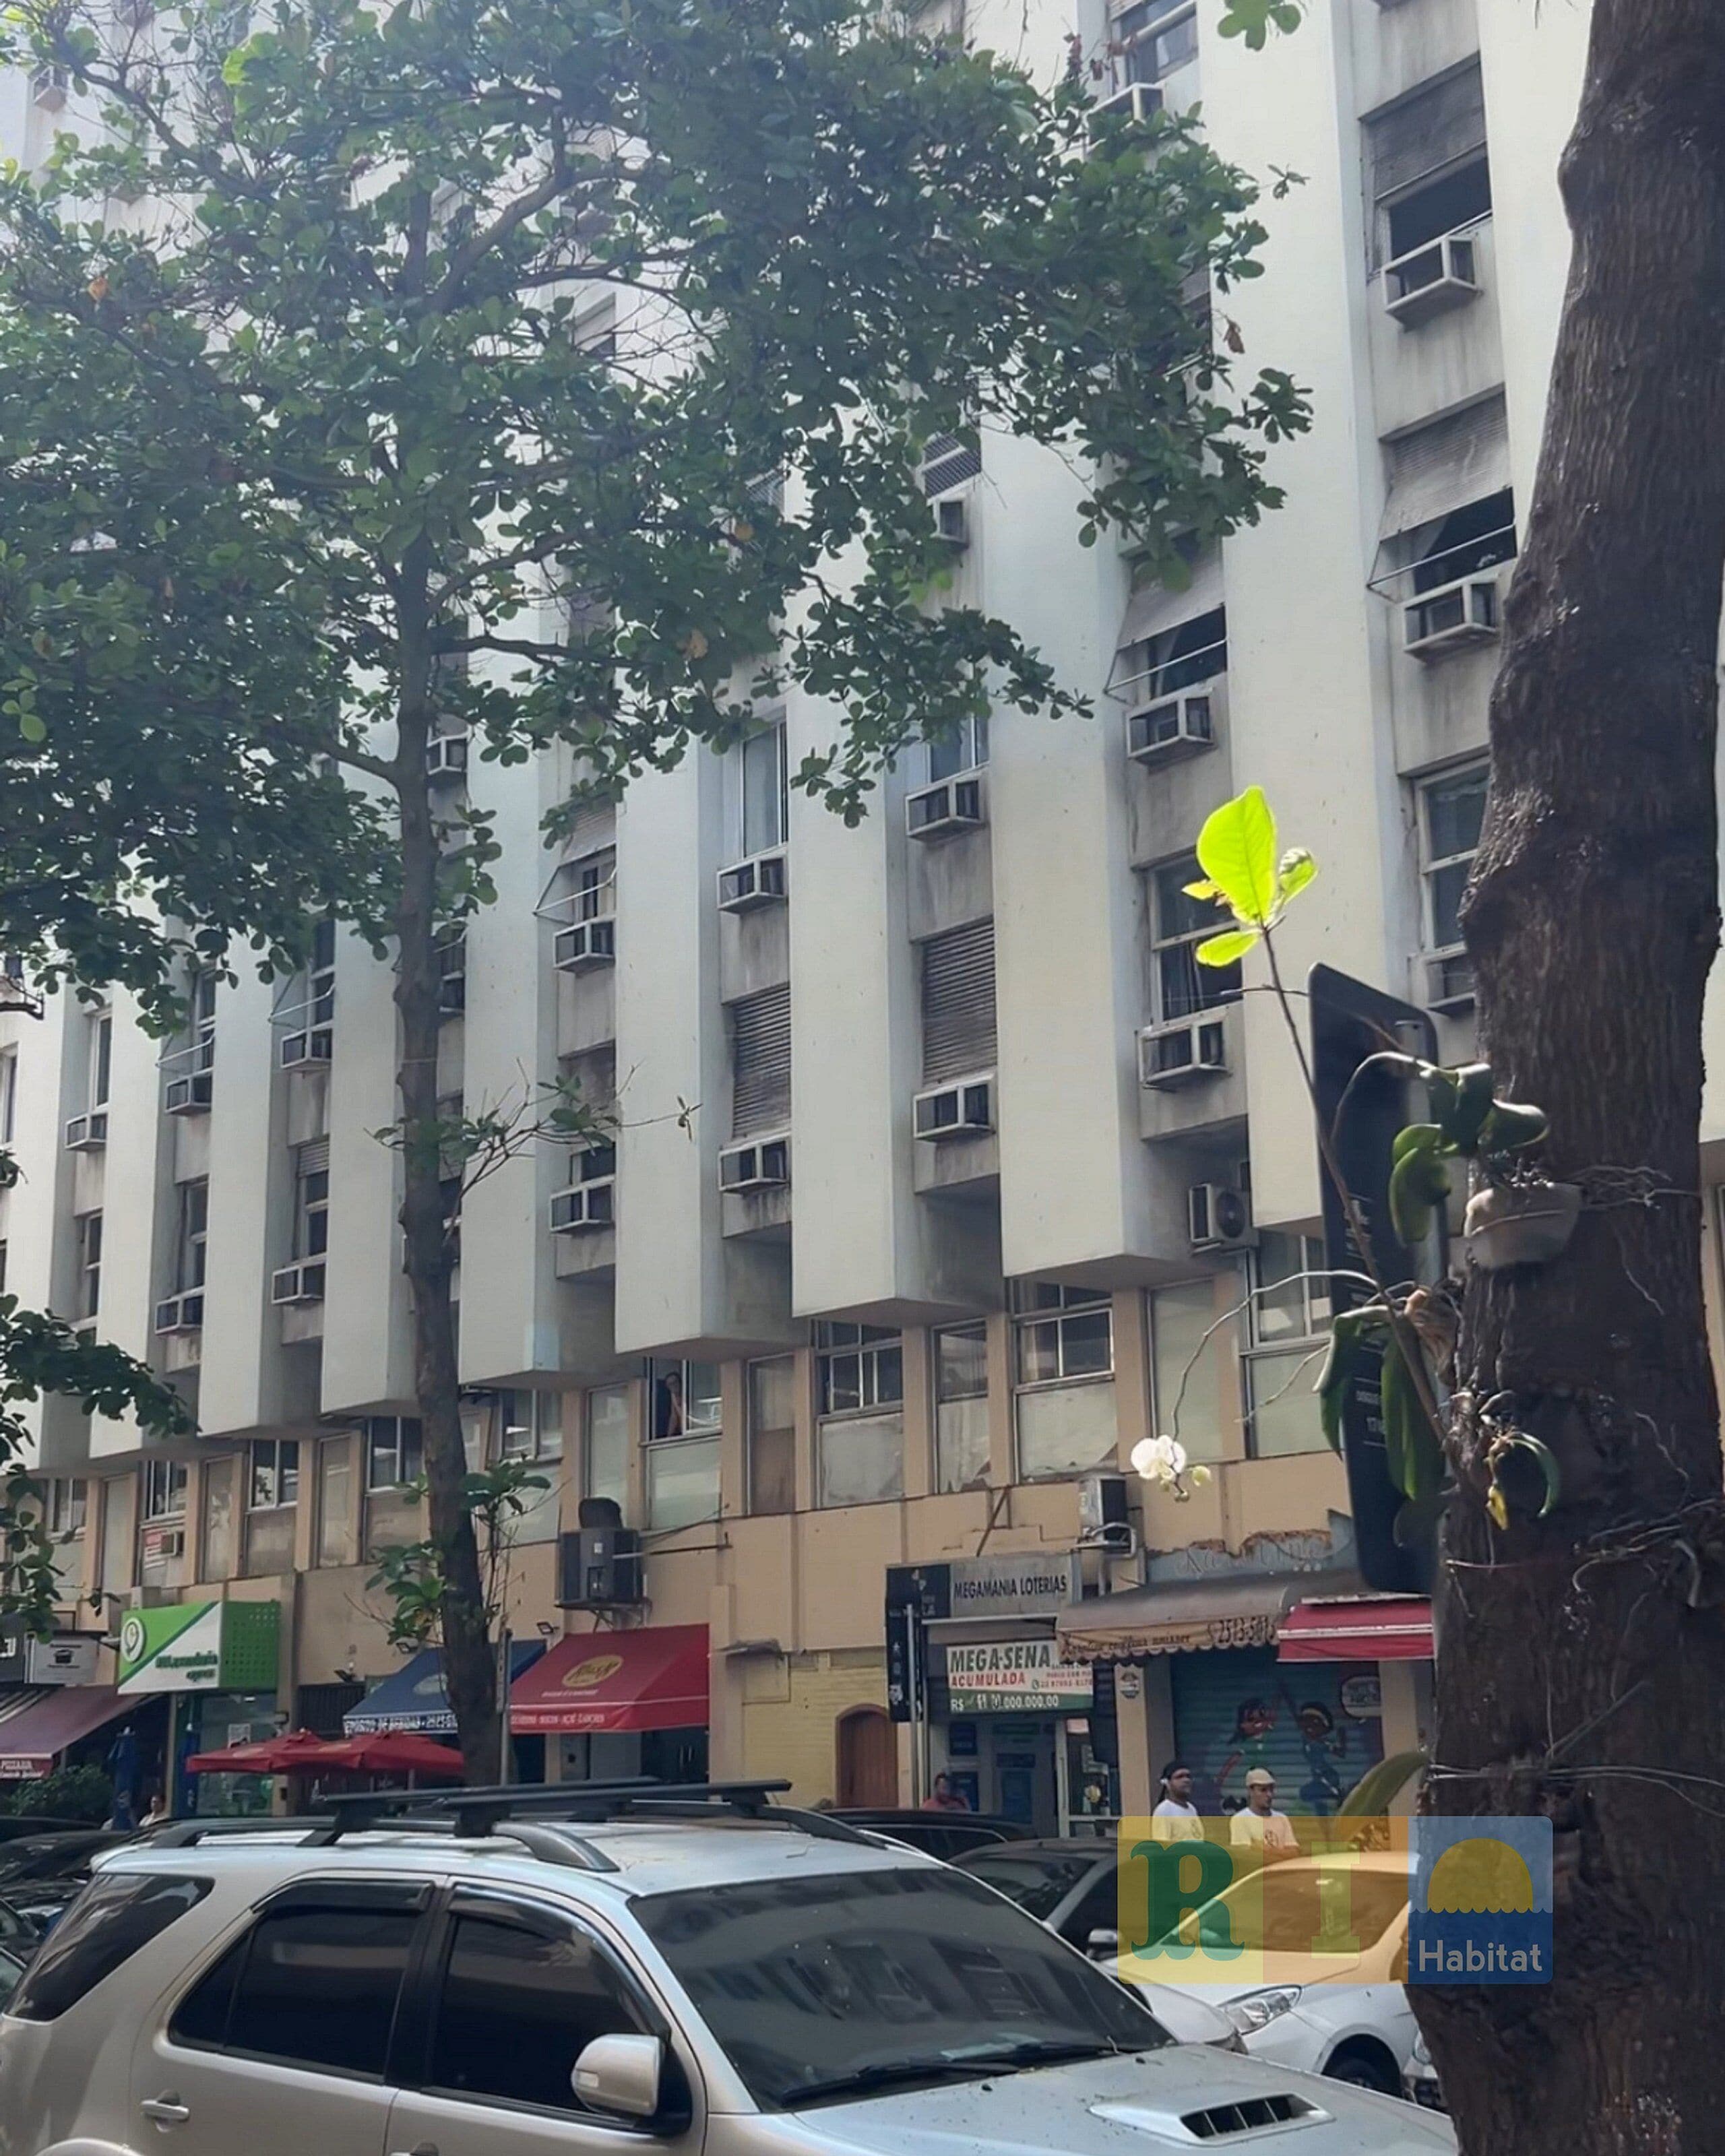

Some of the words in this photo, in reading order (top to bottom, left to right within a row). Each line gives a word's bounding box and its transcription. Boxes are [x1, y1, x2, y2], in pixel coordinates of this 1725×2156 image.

[954, 1578, 1017, 1599] MEGAMANIA
[1020, 1575, 1067, 1595] LOTERIAS
[951, 1672, 1025, 1687] ACUMULADA
